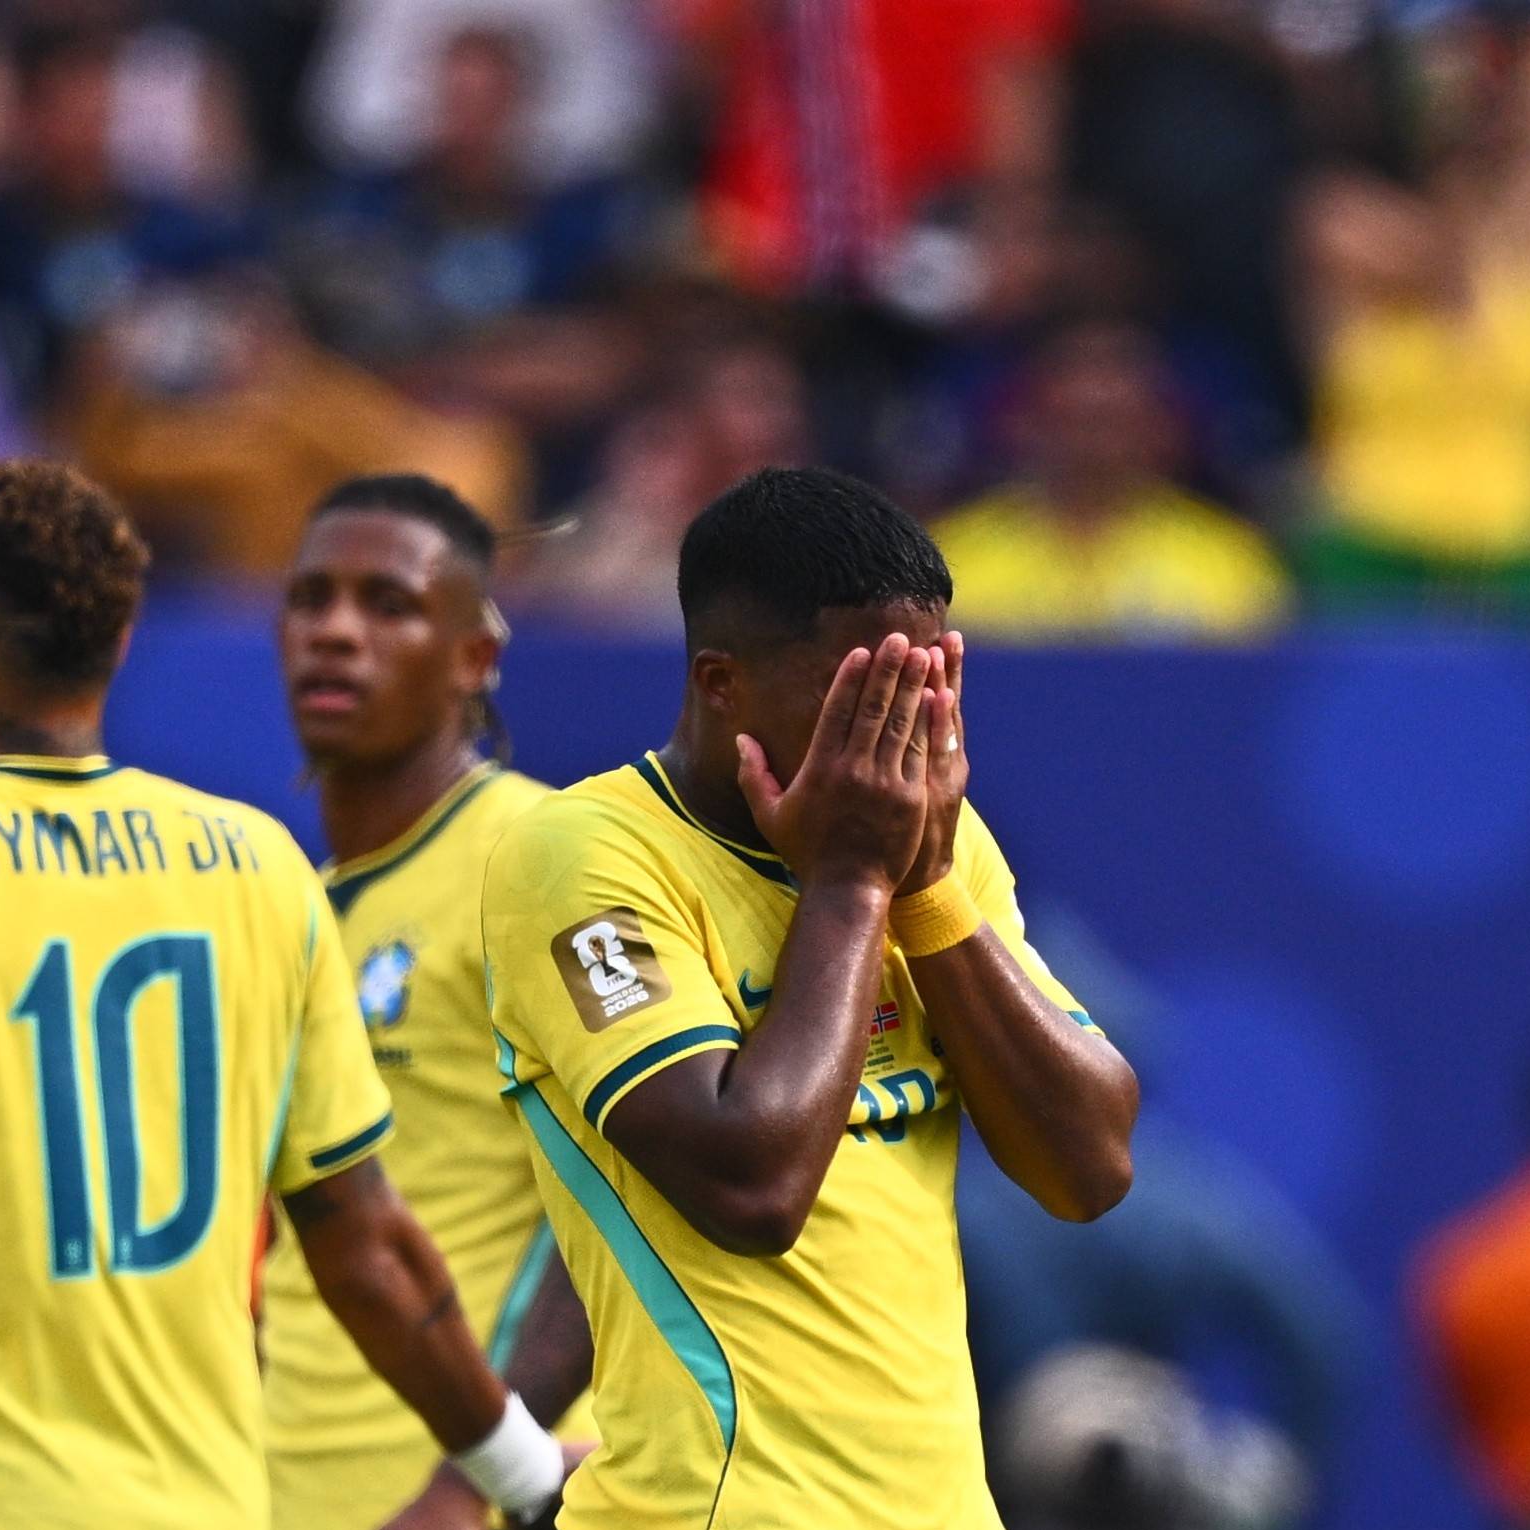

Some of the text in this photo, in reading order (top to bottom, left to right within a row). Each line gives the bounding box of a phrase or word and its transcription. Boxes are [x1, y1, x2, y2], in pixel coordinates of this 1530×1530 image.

[181, 810, 259, 873] JR
[604, 990, 650, 1018] 2026
[11, 932, 222, 1281] 10
